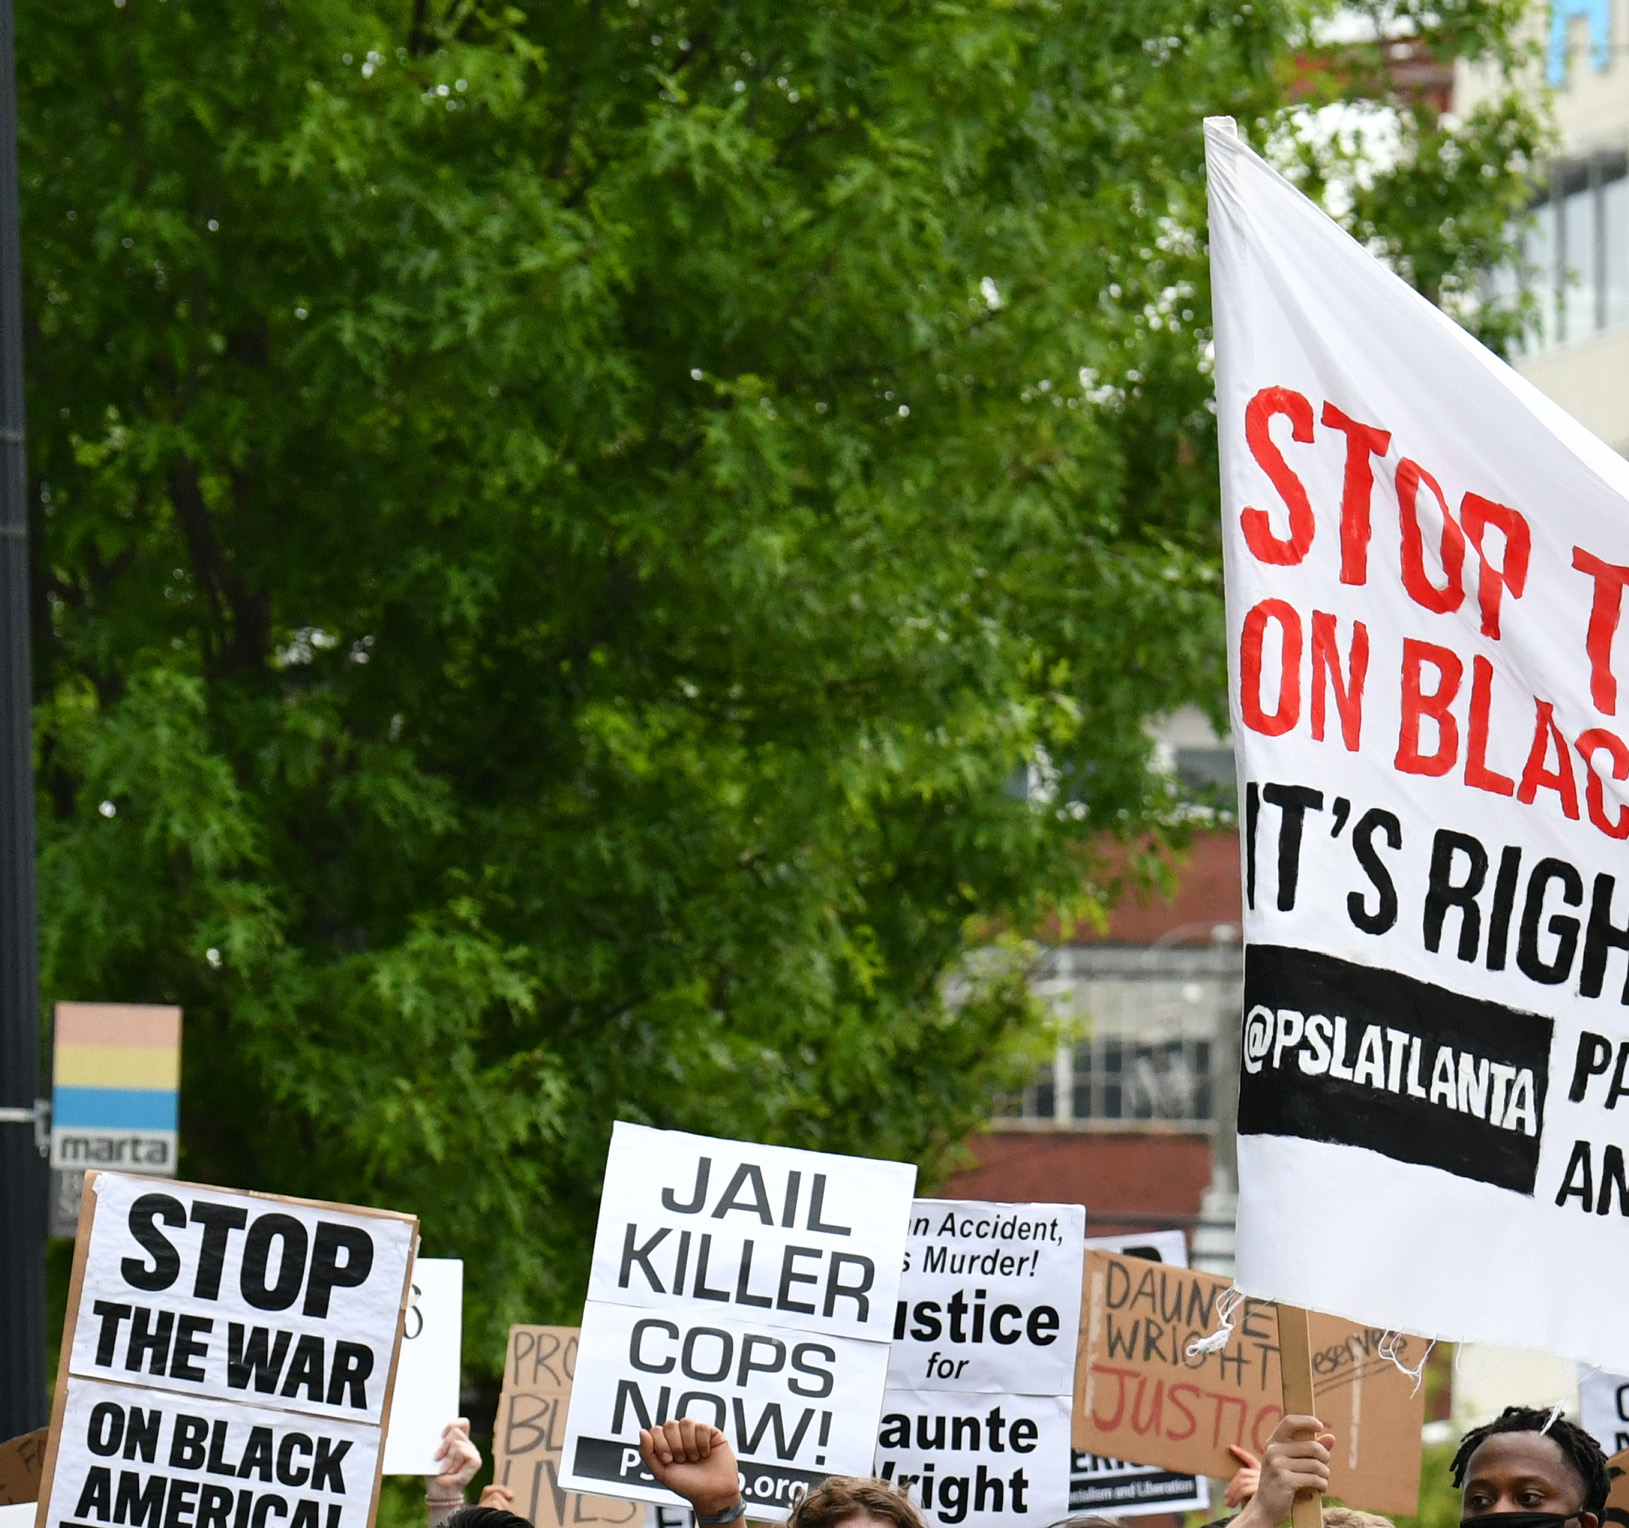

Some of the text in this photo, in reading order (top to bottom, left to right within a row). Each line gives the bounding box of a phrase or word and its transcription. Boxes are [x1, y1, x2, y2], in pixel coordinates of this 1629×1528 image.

[1240, 385, 1531, 641] STOP
[1240, 598, 1368, 752] ON
[1246, 781, 1402, 935] IT'S
[1244, 1004, 1538, 1138] @PSLATLANTA
[61, 1133, 169, 1164] marta
[661, 1156, 852, 1237] JAIL
[937, 1212, 1063, 1247] Accident,
[120, 1192, 374, 1320] STOP
[618, 1222, 876, 1323] KILLER
[922, 1245, 1040, 1277] Murder!
[93, 1299, 375, 1410] THE WAR
[629, 1318, 836, 1399] COPS
[926, 1351, 970, 1380] for
[1313, 1327, 1408, 1374] eserves
[87, 1401, 163, 1464] ON
[168, 1413, 354, 1496] BLACK
[610, 1379, 833, 1466] NOW!
[878, 1405, 1039, 1454] aunte
[1090, 1361, 1332, 1456] JUSTIC
[880, 1460, 1029, 1525] right
